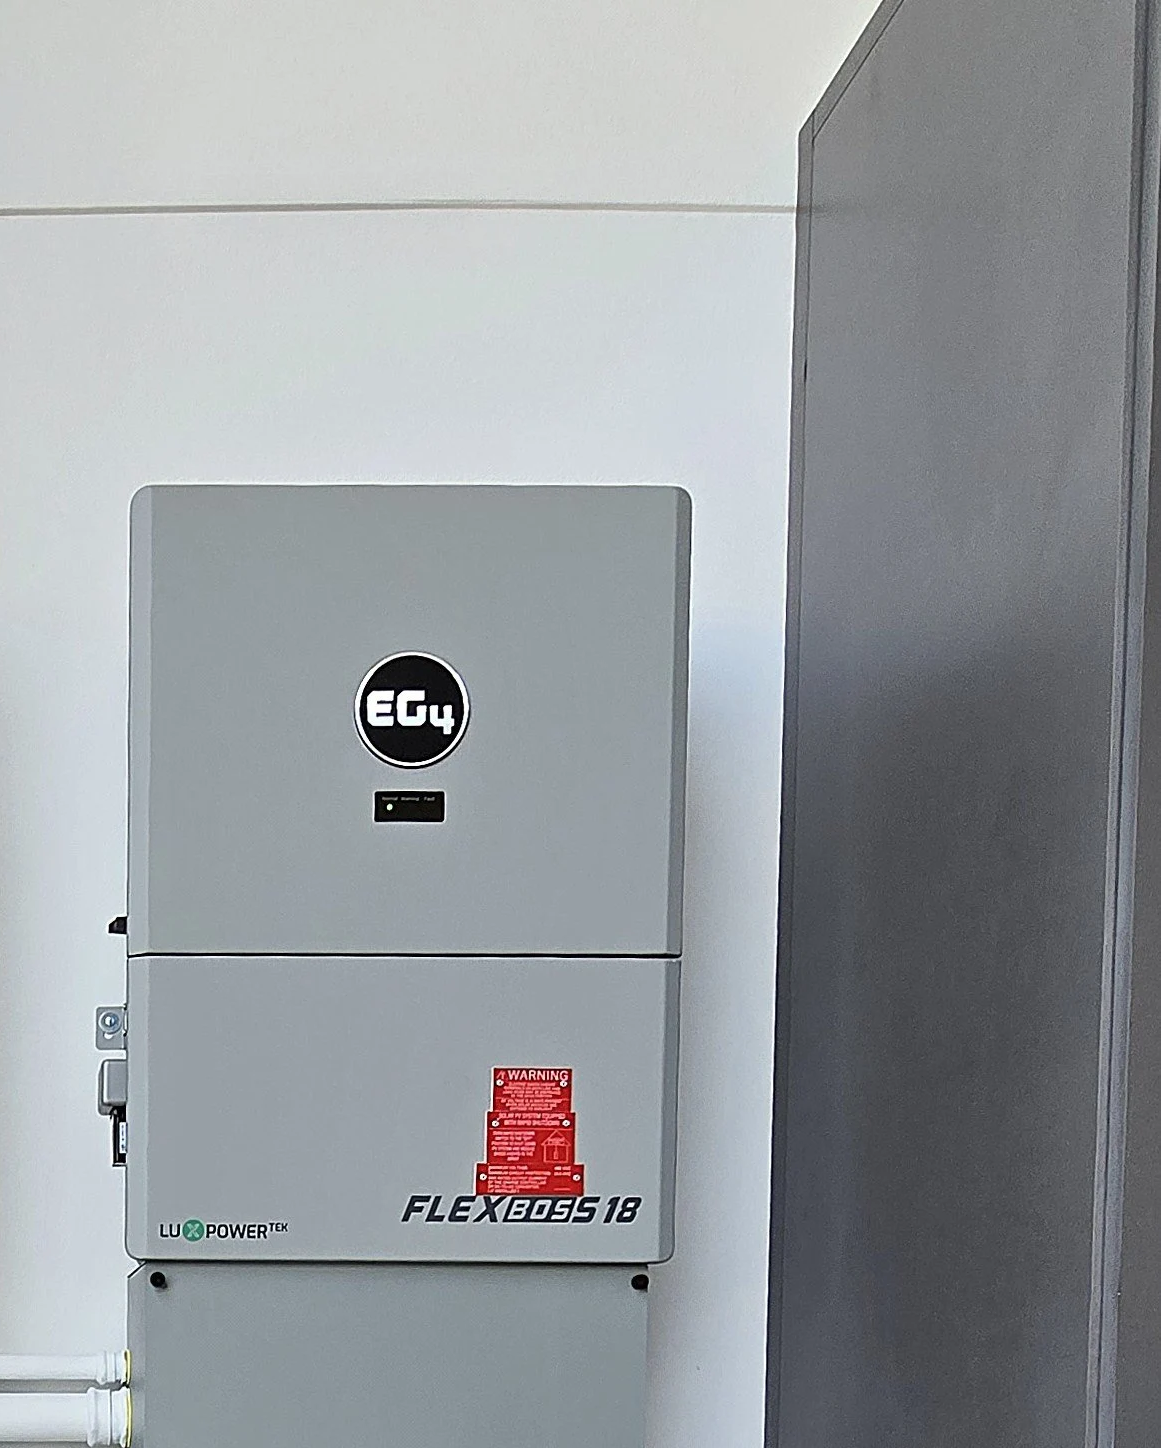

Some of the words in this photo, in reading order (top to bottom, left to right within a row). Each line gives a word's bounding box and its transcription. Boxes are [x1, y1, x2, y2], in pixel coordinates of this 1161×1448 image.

[366, 689, 455, 735] EG4
[507, 1069, 569, 1081] WARNING
[603, 1196, 642, 1223] 18
